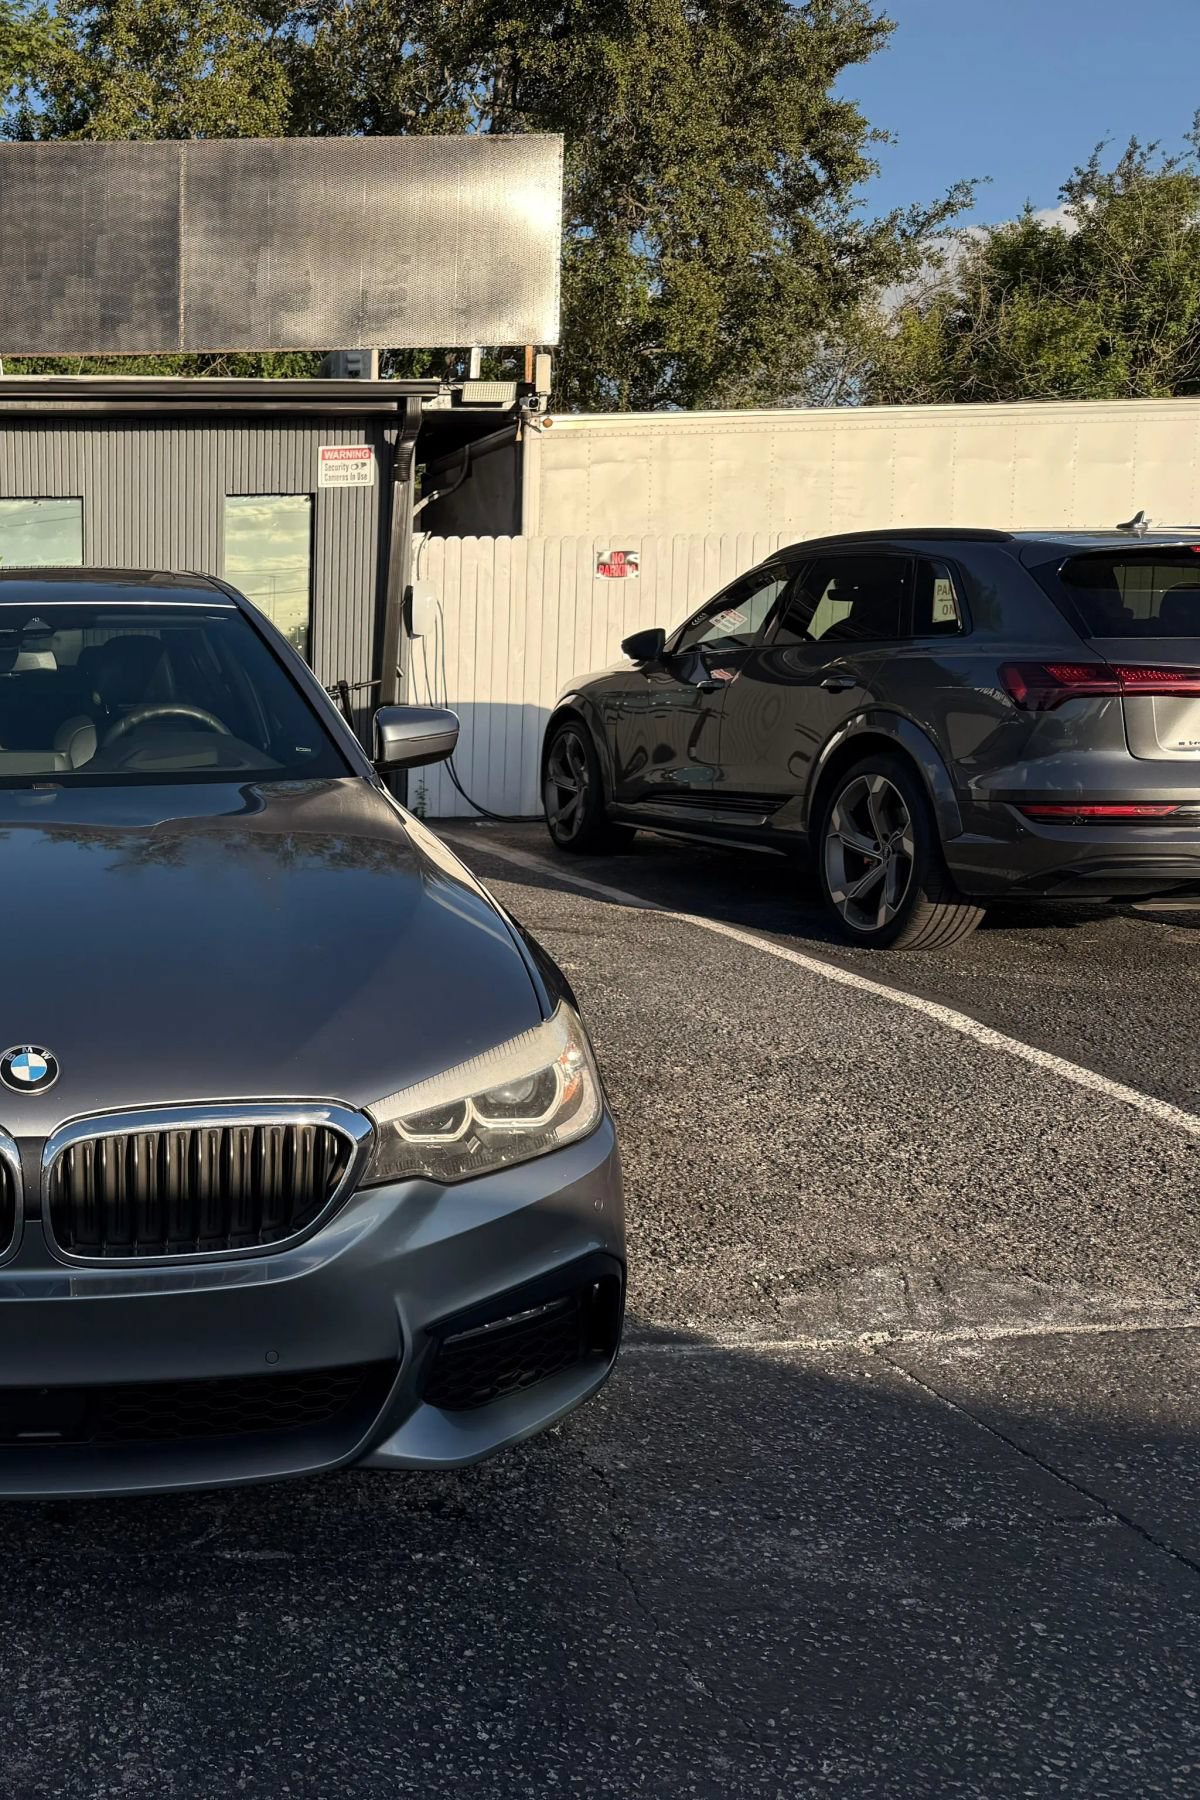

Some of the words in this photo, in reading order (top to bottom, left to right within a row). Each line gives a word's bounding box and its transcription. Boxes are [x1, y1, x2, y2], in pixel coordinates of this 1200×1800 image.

[324, 449, 370, 460] WARNING
[324, 462, 350, 472] Security
[324, 473, 349, 482] Cameras
[611, 552, 625, 564] NO
